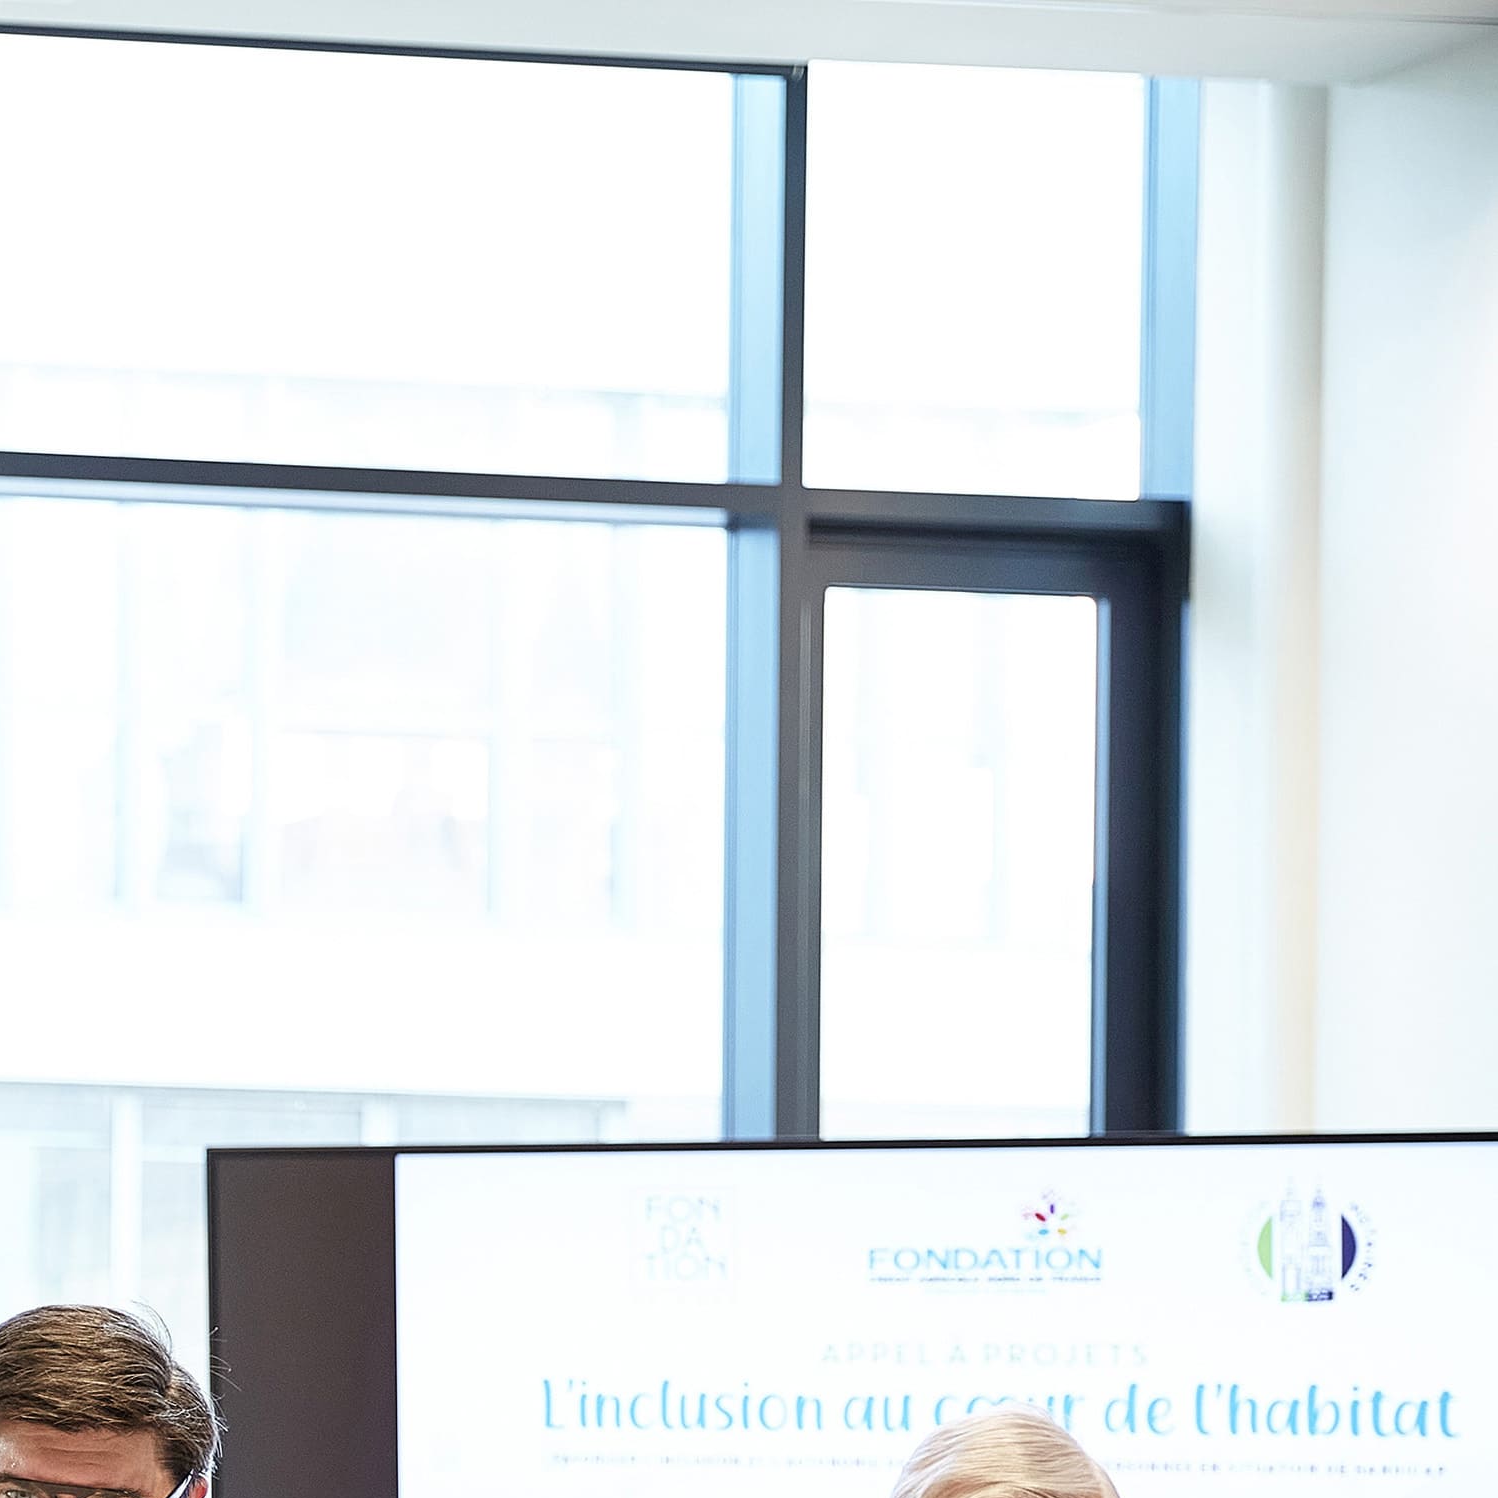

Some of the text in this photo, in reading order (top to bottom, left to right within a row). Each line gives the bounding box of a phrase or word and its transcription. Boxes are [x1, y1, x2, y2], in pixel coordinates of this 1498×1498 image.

[868, 1247, 1104, 1271] FONDATION
[820, 1341, 930, 1366] APPEL
[981, 1342, 1150, 1368] PROJETS
[542, 1379, 824, 1432] L'inclusion
[843, 1394, 912, 1432] au
[1104, 1383, 1175, 1436] de
[1195, 1383, 1462, 1438] l'habitat
